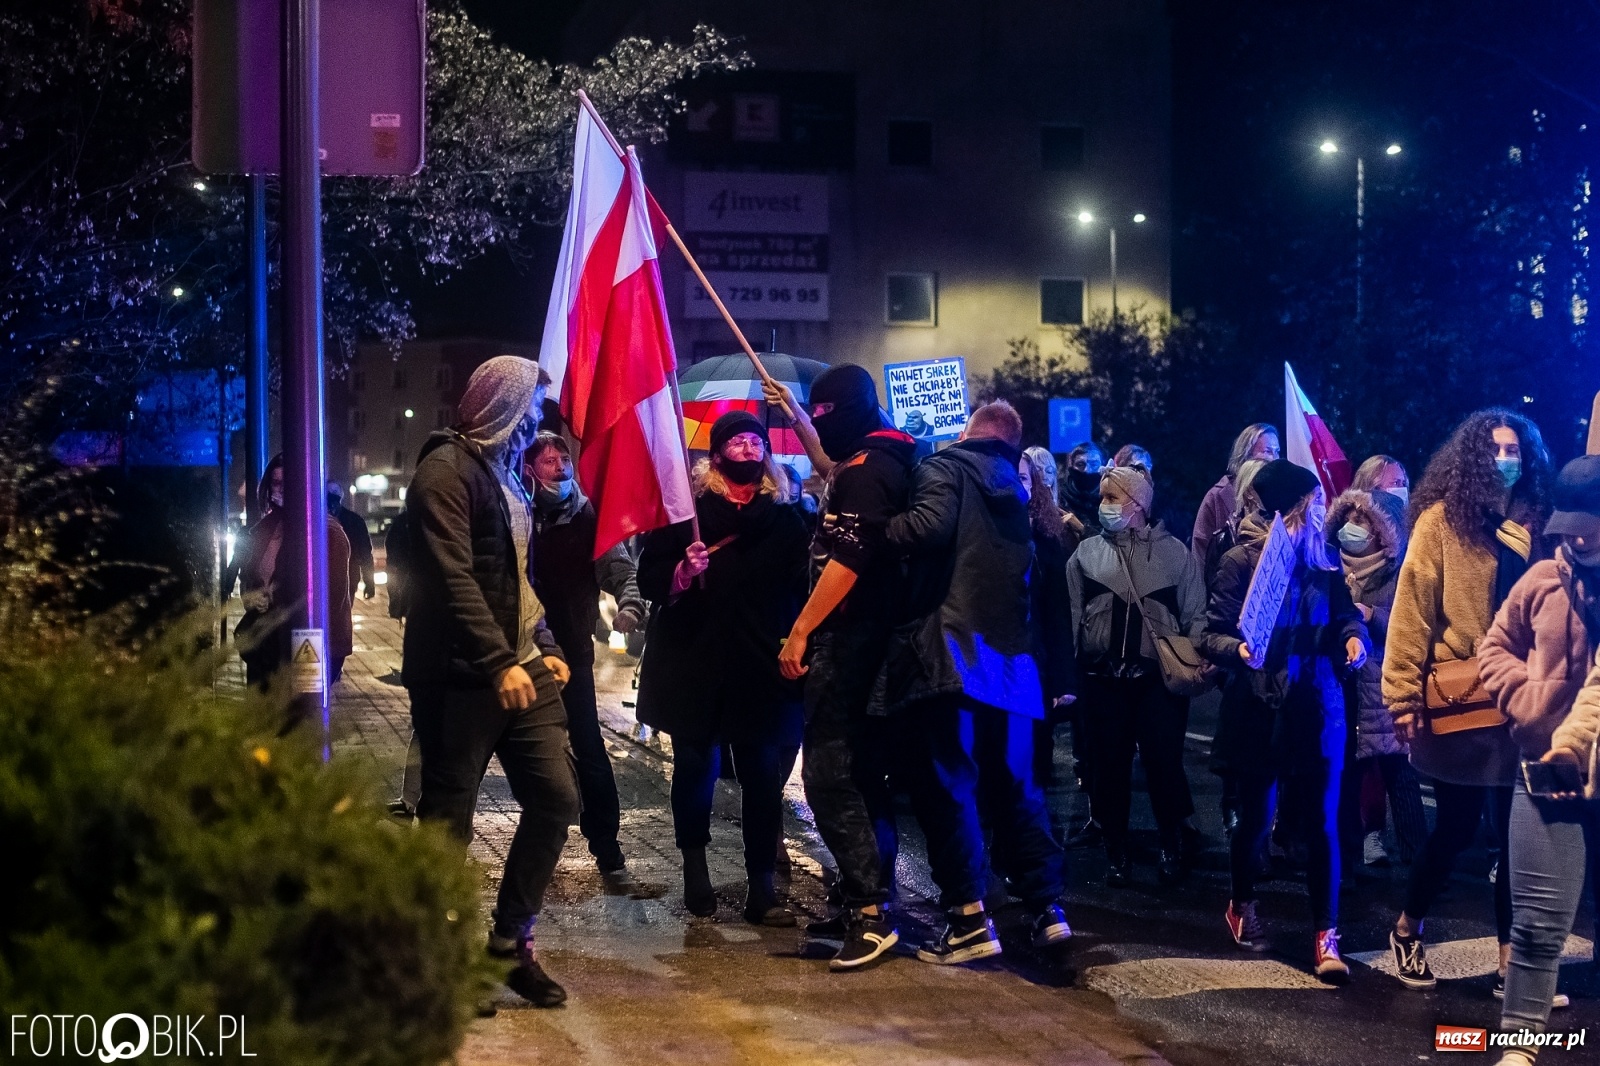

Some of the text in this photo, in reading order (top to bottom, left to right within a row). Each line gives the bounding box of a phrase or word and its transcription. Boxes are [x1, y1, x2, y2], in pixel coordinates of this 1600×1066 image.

[728, 286, 763, 302] 729
[768, 288, 792, 303] 96
[797, 288, 820, 303] 95
[890, 364, 957, 382] NAWET SHREK
[893, 376, 959, 396] NIE CHCIAŁBY
[896, 389, 962, 409] MIESZKAĆ NA
[933, 401, 962, 414] TAKIM
[934, 413, 966, 428] BAGNIE
[1060, 406, 1081, 437] P
